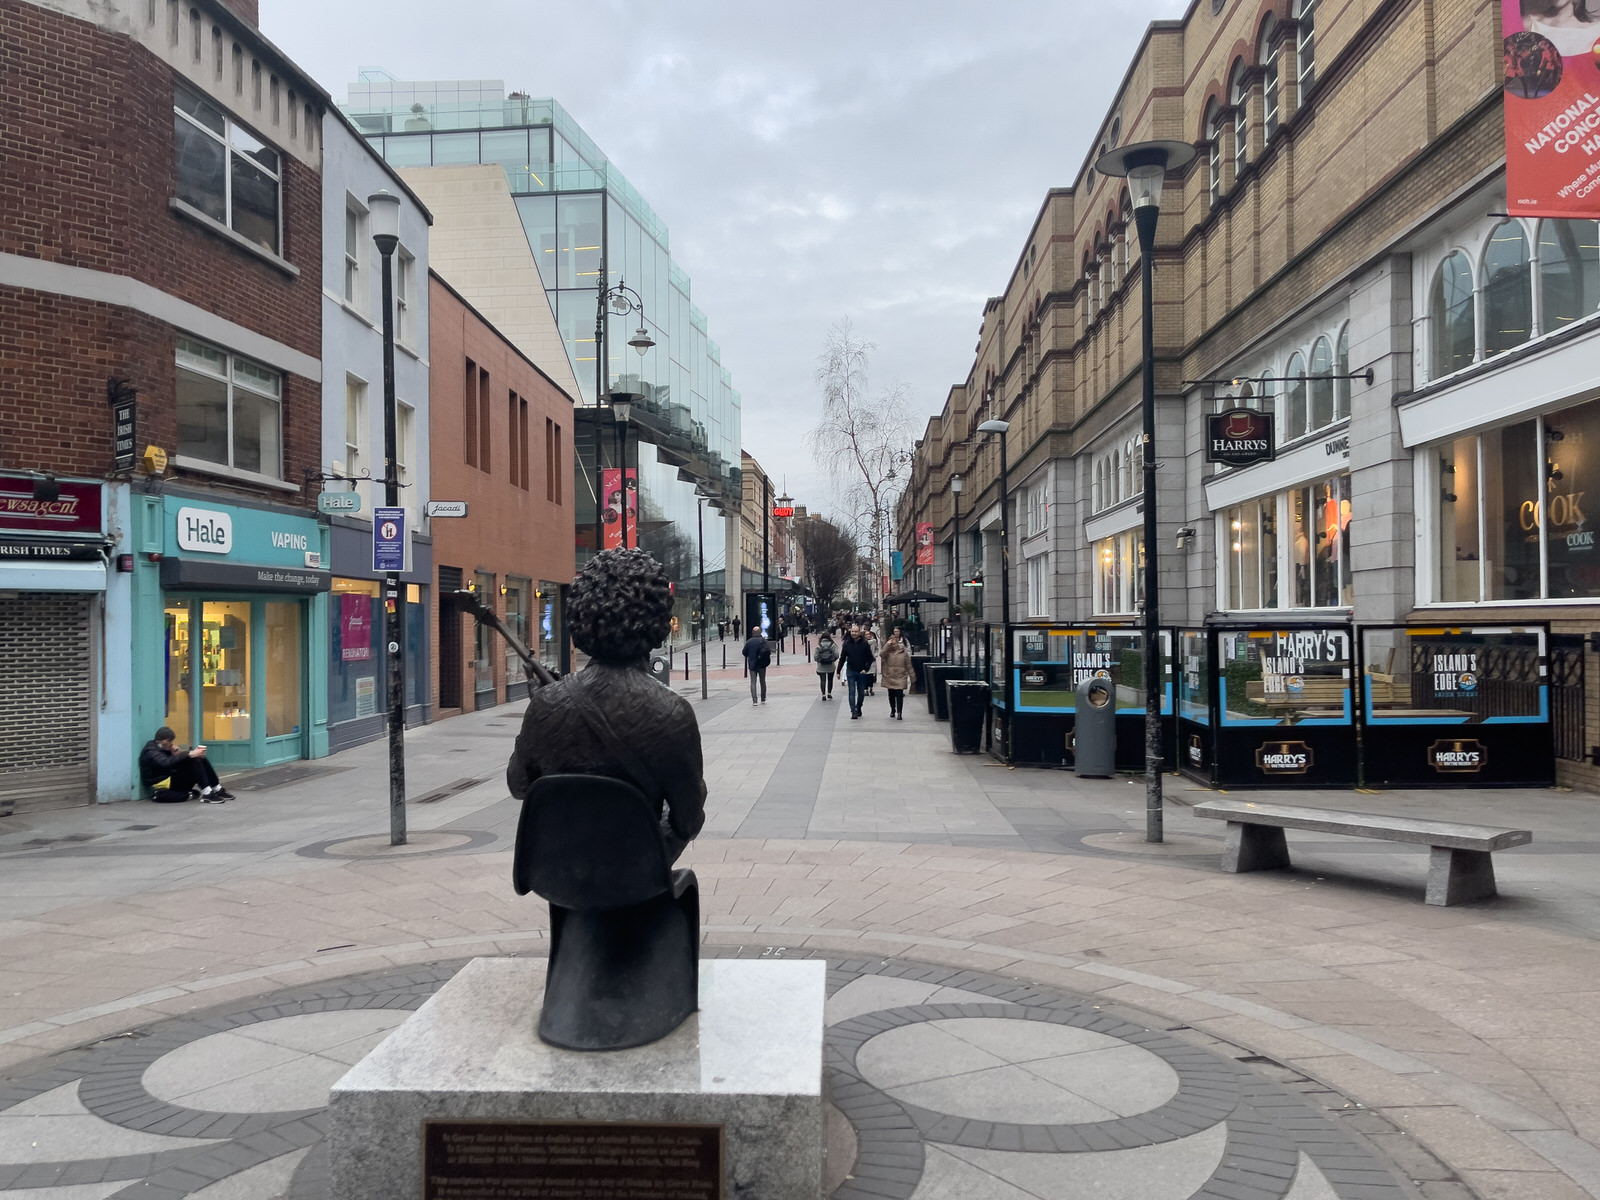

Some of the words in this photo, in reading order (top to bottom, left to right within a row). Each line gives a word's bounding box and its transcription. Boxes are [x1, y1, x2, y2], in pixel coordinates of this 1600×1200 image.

[1524, 92, 1599, 155] NATIONAL
[1557, 174, 1587, 198] Where
[118, 408, 130, 420] THE
[117, 423, 132, 436] IRISH
[116, 438, 133, 451] TIMES
[1212, 439, 1267, 451] HARRYS
[322, 496, 354, 509] Hale
[185, 517, 225, 545] Hale
[1566, 531, 1594, 547] COOK
[271, 531, 307, 550] VAPING
[32, 546, 71, 555] TIMES
[257, 571, 273, 581] Make
[274, 571, 284, 582] the
[305, 575, 320, 586] today
[1276, 629, 1337, 662] HARRY'S
[1073, 652, 1111, 669] ISLAND'S
[1263, 656, 1304, 674] ISLAND'S
[1433, 653, 1477, 672] ISLAND'S
[1263, 675, 1286, 693] EDGE
[1434, 673, 1458, 691] EDGE
[1263, 753, 1306, 764] HARRYS
[1435, 751, 1480, 762] HARRYS
